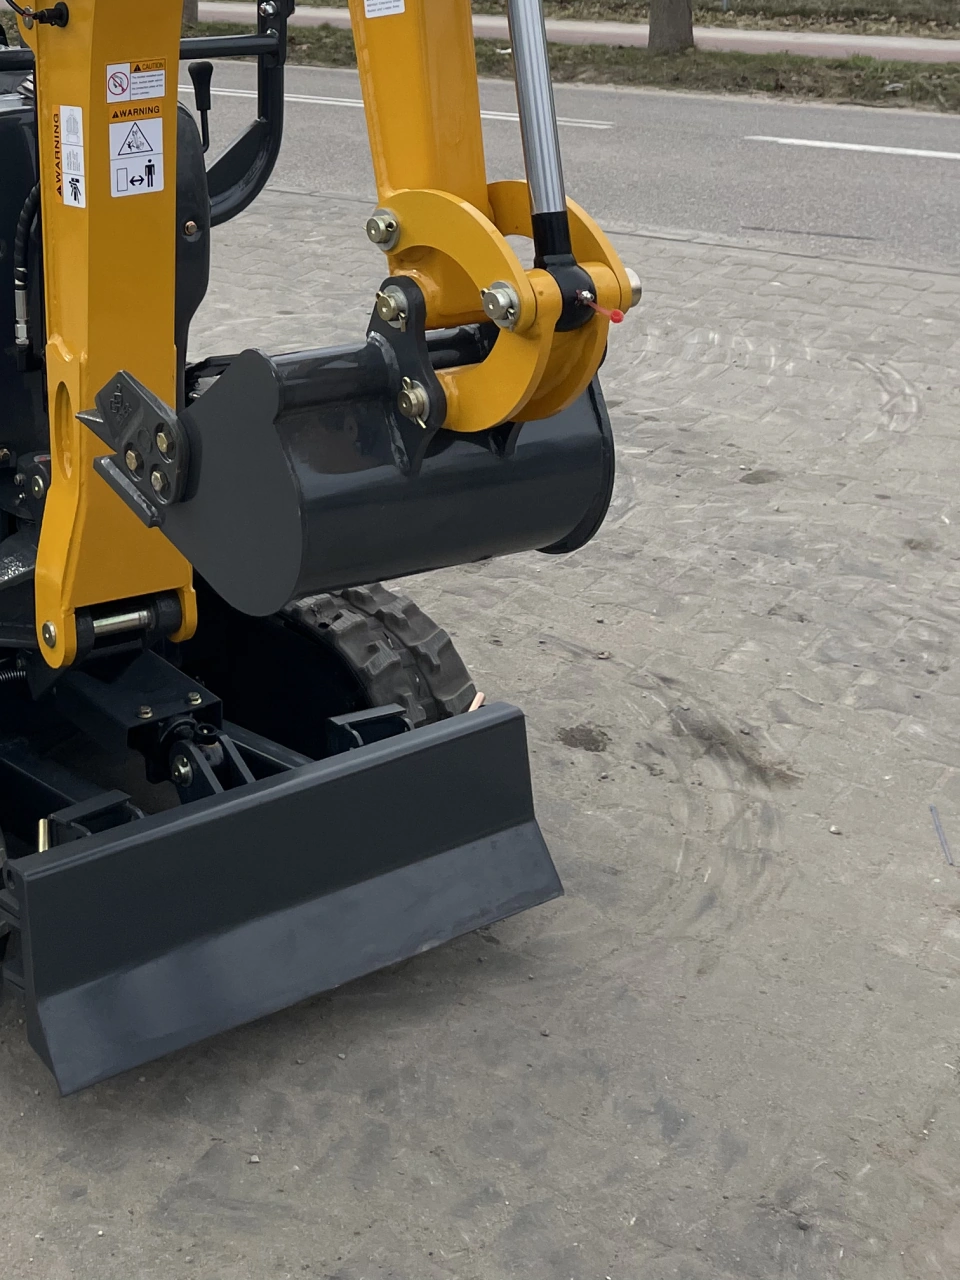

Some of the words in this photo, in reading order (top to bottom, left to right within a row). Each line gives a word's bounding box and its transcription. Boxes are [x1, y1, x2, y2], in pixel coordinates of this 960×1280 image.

[141, 62, 164, 70] CAUTION
[120, 105, 160, 117] WARNING
[53, 113, 62, 183] WARNING
